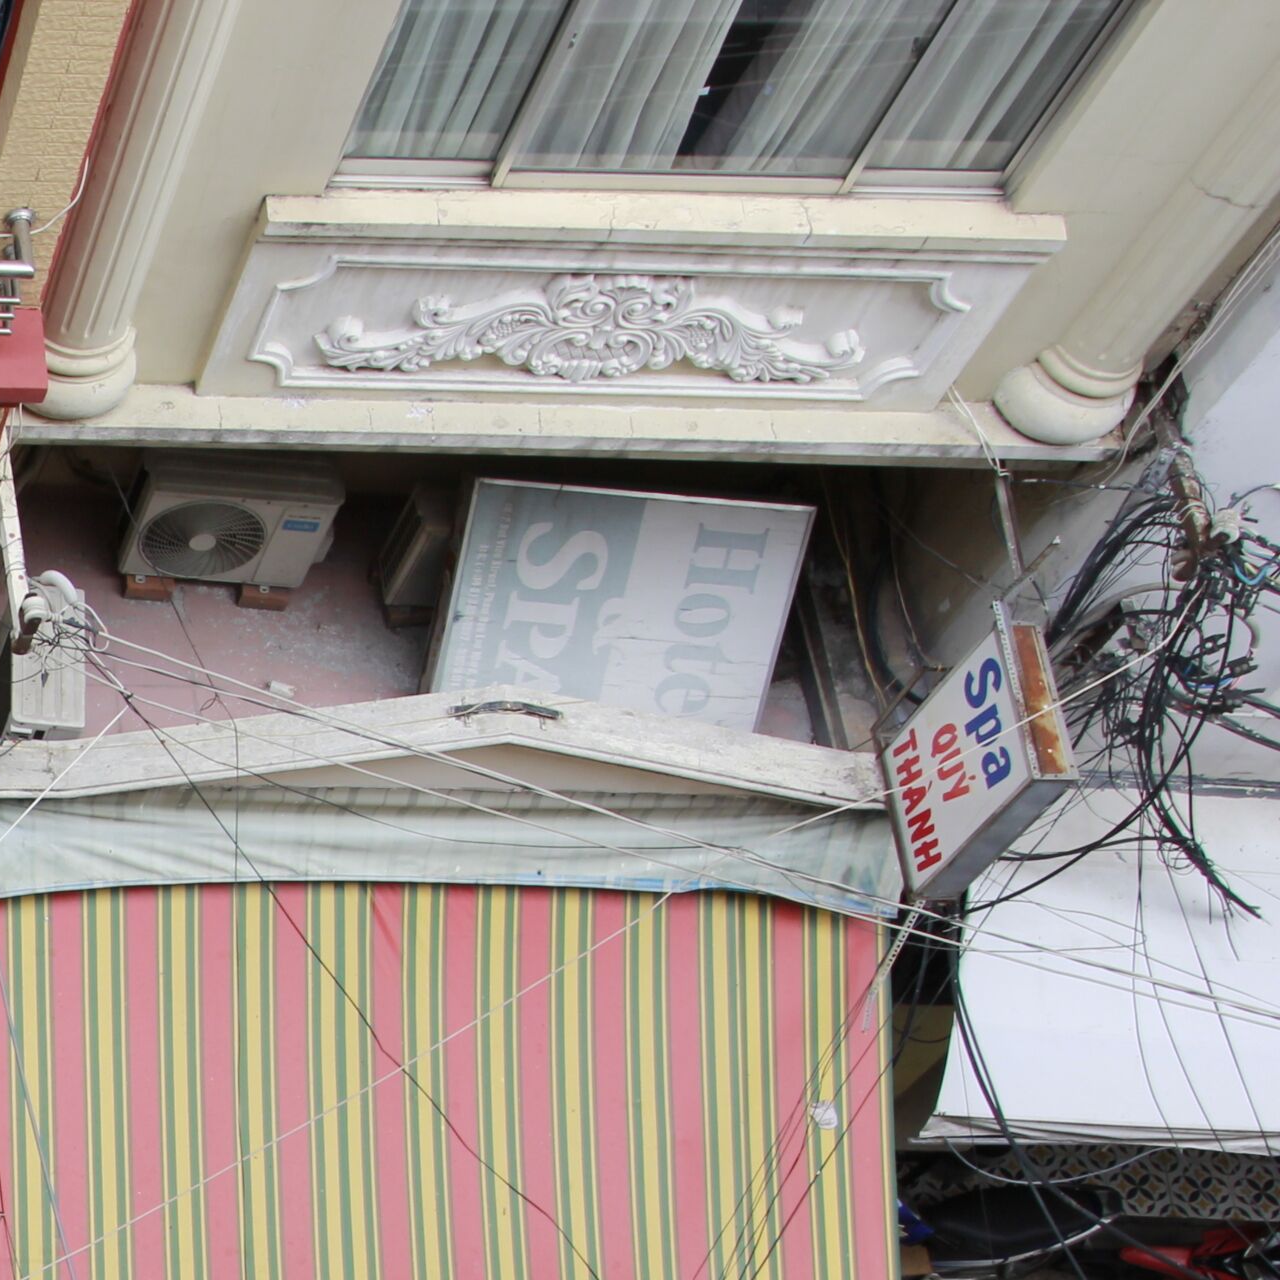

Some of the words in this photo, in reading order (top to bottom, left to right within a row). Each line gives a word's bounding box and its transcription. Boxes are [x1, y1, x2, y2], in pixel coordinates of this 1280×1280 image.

[496, 522, 609, 696] SPA
[654, 522, 770, 719] Hote
[893, 728, 942, 872] THÀNH
[964, 658, 1012, 789] Spa
